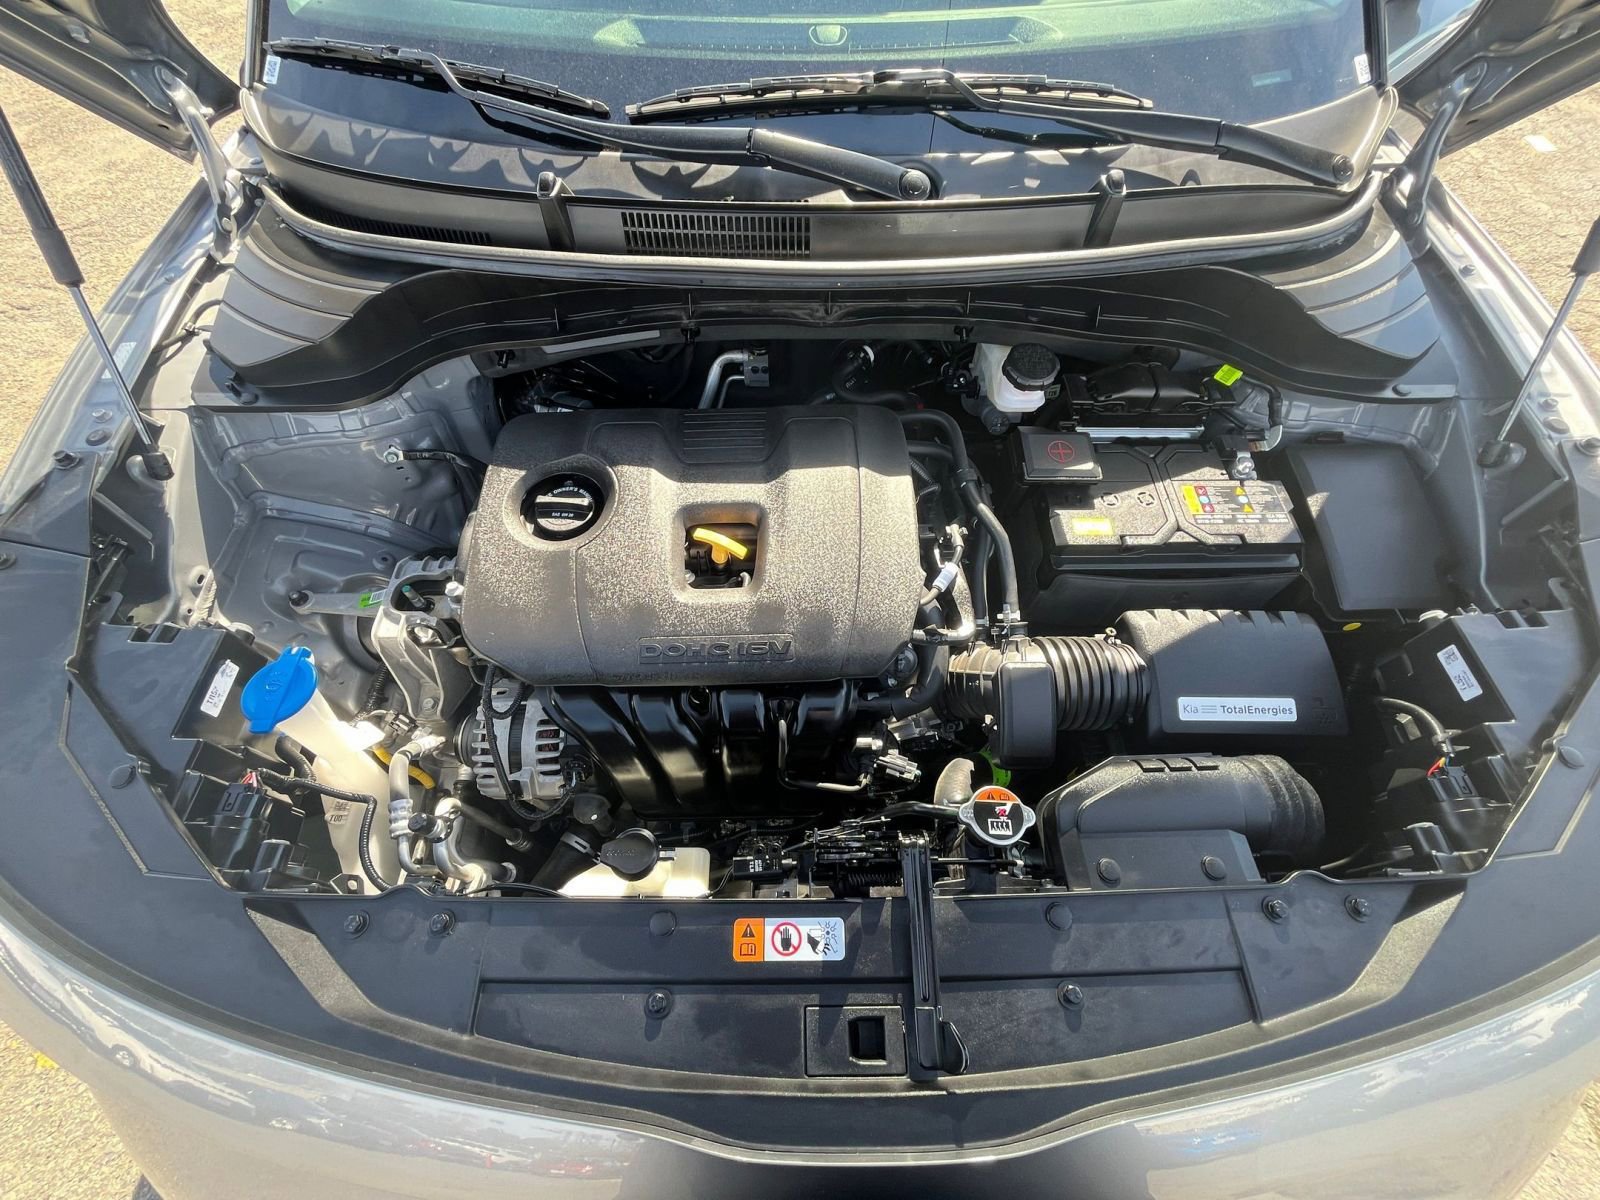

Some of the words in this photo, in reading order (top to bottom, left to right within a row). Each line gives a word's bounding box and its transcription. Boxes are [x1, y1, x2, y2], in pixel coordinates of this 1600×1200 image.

[639, 641, 730, 658] DOHC
[736, 640, 792, 656] 16V
[1183, 704, 1199, 714] Kia
[1220, 705, 1293, 716] TotalEnergies
